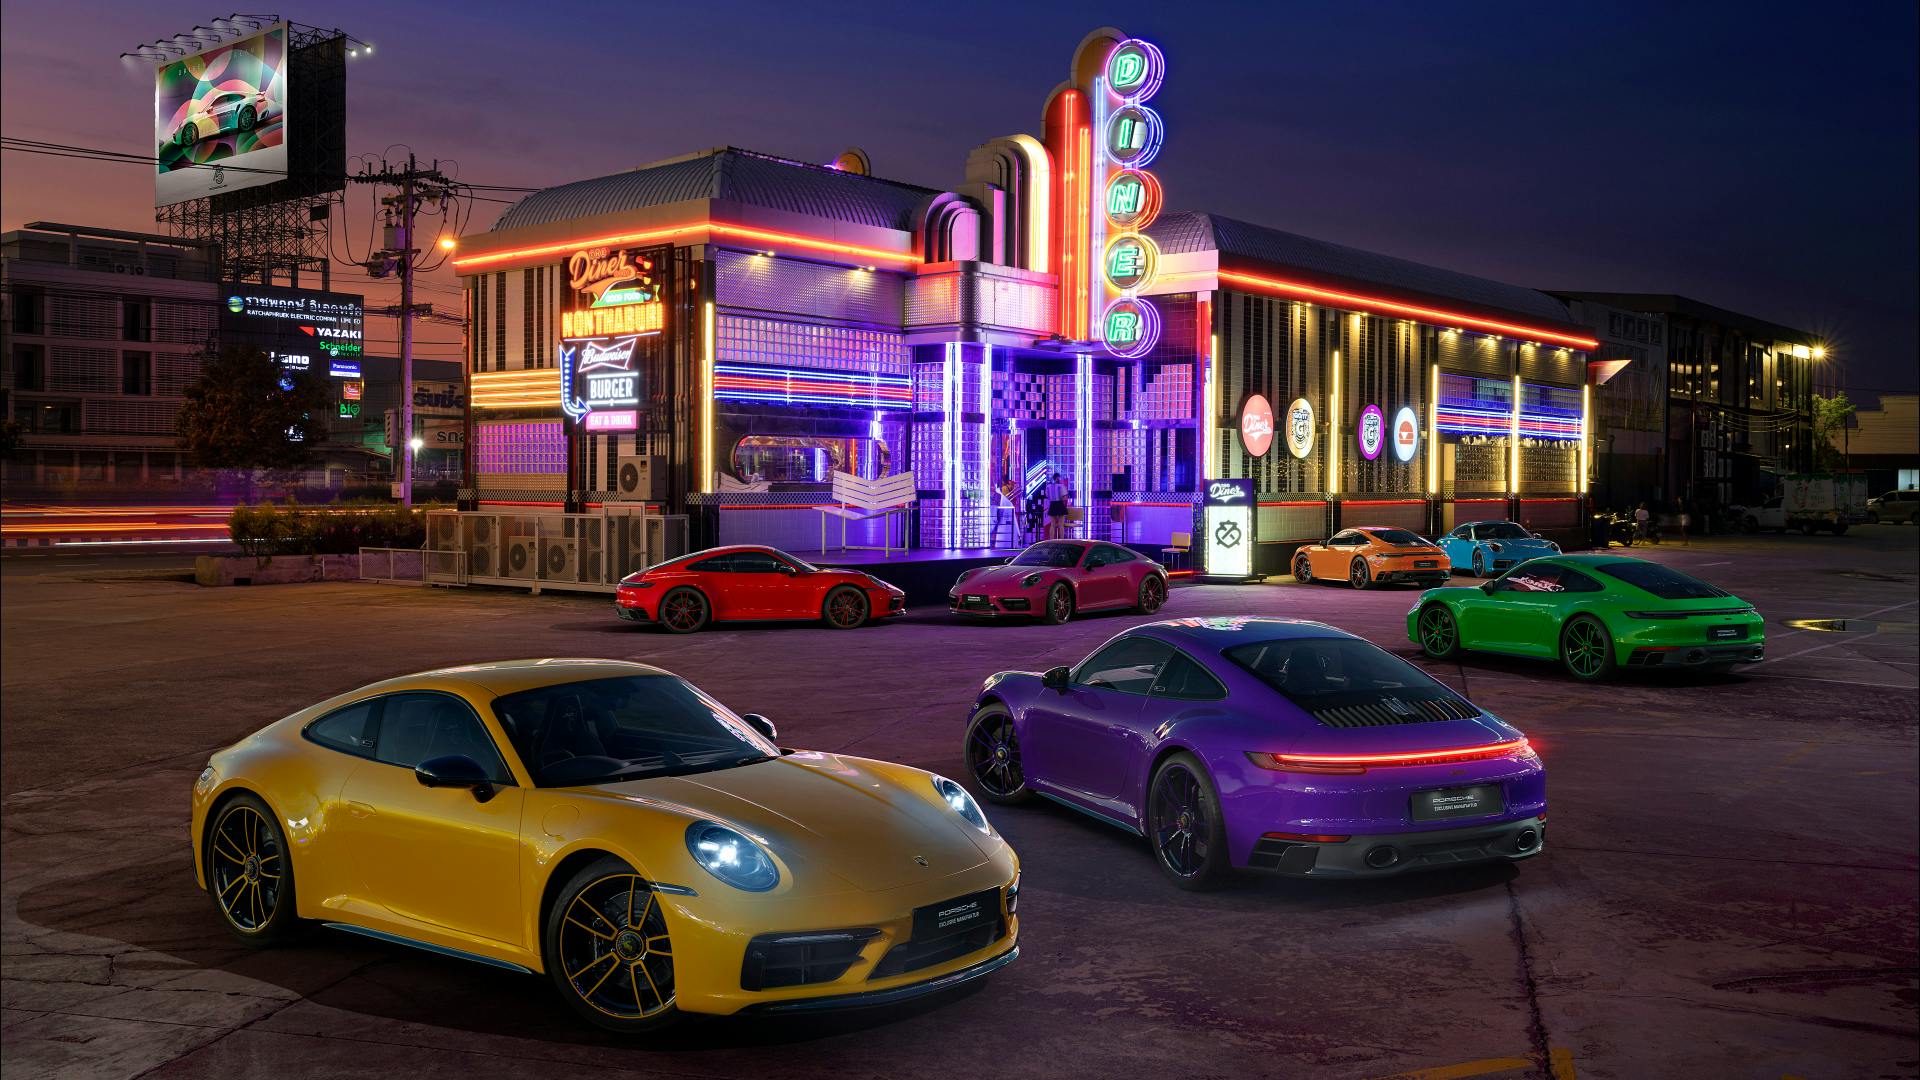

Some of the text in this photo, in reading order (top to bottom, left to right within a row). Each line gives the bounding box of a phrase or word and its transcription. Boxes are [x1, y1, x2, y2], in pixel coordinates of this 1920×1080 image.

[1108, 53, 1144, 343] DINER
[569, 249, 635, 290] Diner
[562, 302, 664, 338] NONTHABURI
[317, 327, 361, 339] YAZAKI
[319, 341, 361, 353] Schneider
[581, 347, 633, 364] Budweiser
[590, 377, 633, 399] BURGER
[1210, 483, 1246, 499] Diner
[938, 901, 978, 917] PORSCHE
